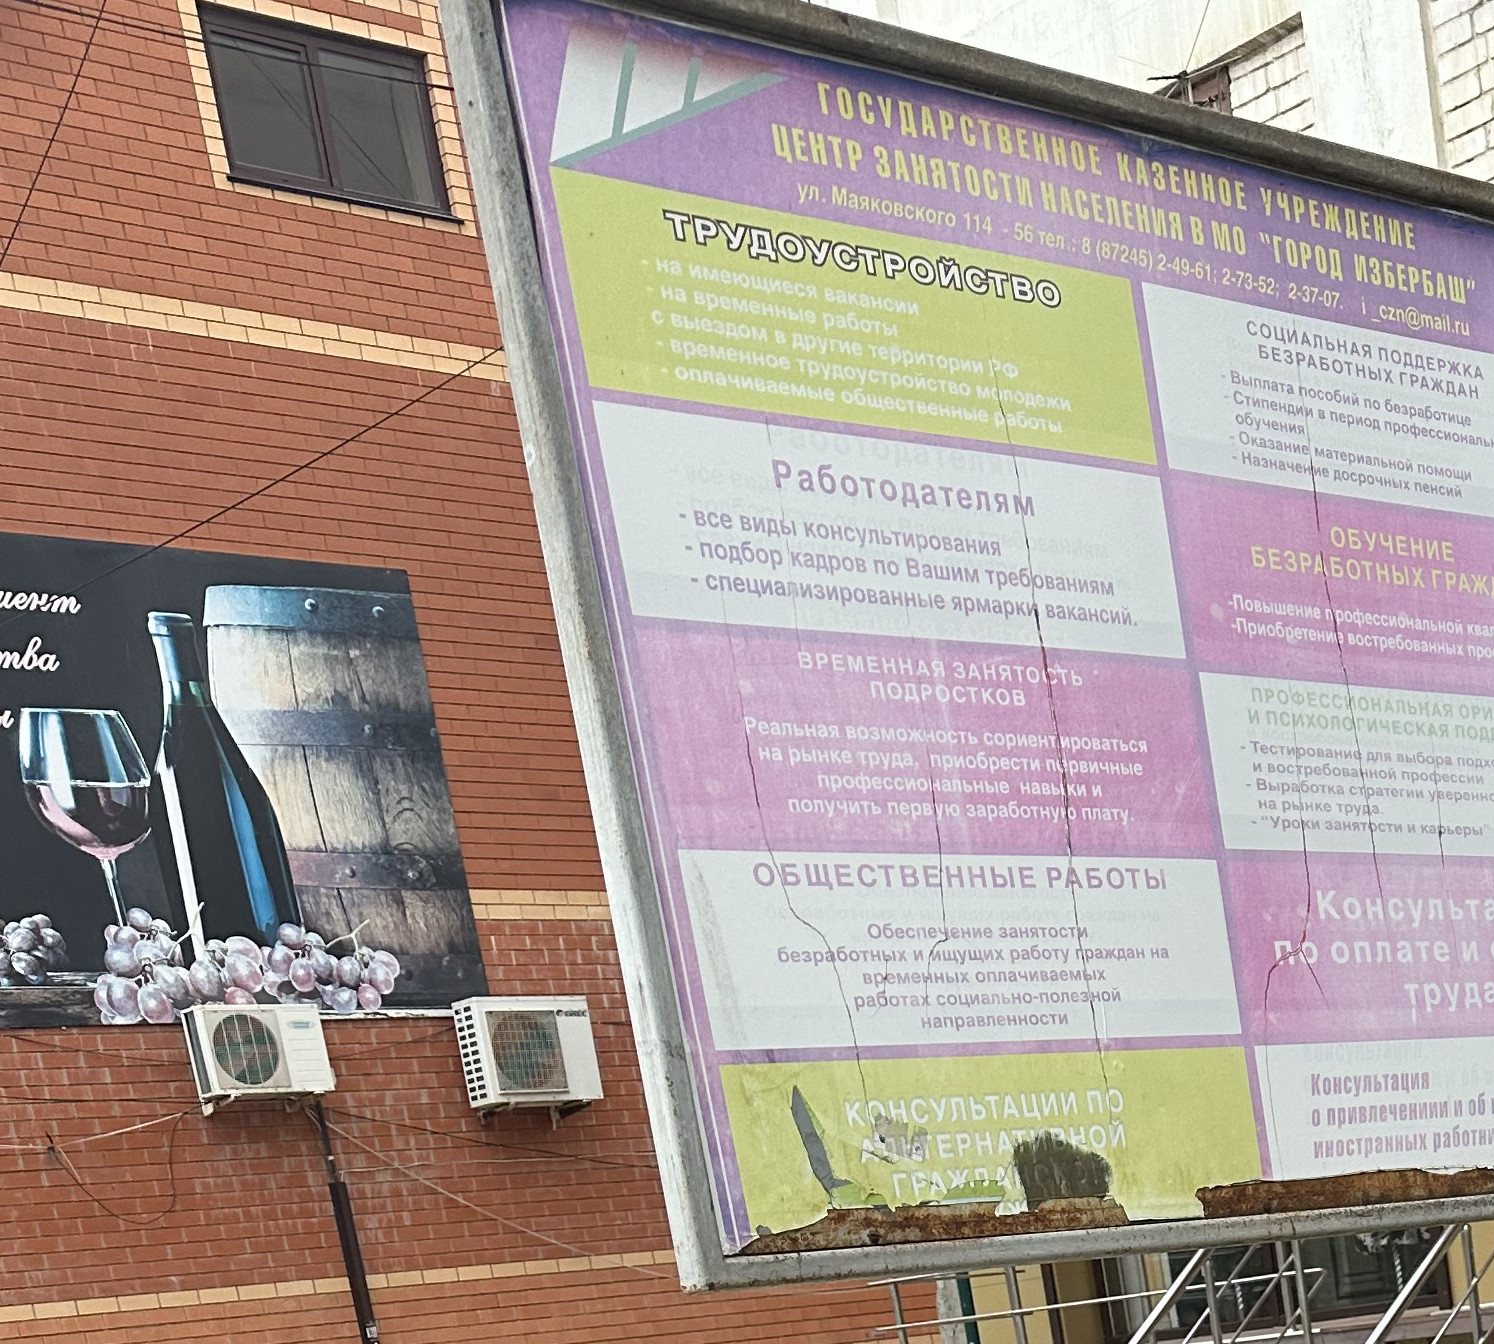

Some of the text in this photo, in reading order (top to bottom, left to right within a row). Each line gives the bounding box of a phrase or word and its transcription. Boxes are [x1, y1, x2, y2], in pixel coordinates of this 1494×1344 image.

[817, 82, 1416, 251] ГОСУДАРСТВЕННОЕ КАЗЕННОЕ УЧРЕЖДЕНИЕ
[771, 123, 862, 172] ЦЕНТР
[873, 145, 1033, 208] ЗАНЯТОСТИ
[1040, 181, 1184, 242] НАСЕЛЕНИЯ
[1189, 215, 1204, 246] В
[1210, 220, 1246, 256] МО
[661, 208, 1062, 309] ТРУДОУСТРОЙСТВО
[796, 182, 826, 204] ул.
[831, 185, 956, 228] Маяковского
[963, 212, 992, 238] 114
[1013, 222, 1034, 243] 56
[1081, 236, 1091, 255] 8
[1095, 239, 1153, 273] (87245)
[1156, 252, 1217, 286] 2-49-61;
[1221, 267, 1280, 299] 2-73-52;
[1245, 320, 1484, 381] СОЦИАЛЬНАЯ ПОДДЕРЖКА
[1257, 343, 1479, 399] БЕЗРАБОТНЫХ ГРАЖДАН
[1229, 369, 1472, 427] Выплата пособий по безработице
[1232, 390, 1314, 422] Стипендии
[1317, 408, 1326, 420] в
[1329, 410, 1381, 432] период
[771, 459, 1035, 524] Работодателям
[693, 509, 1002, 557] все виды консультирования
[1330, 525, 1454, 562] ОБУЧЕНИЕ
[699, 540, 1115, 597] подбор кадров по Вашим требованиям
[1250, 545, 1425, 588] БЕЗРАБОТНЫХ
[705, 573, 1138, 627] специализированные ярмарки вакансий.
[797, 650, 1083, 688] ВРЕМЕННАЯ ЗАНЯТОСТЬ
[870, 680, 1026, 707] ПОДРОСТКОВ
[752, 858, 1167, 895] ОБЩЕСТВЕННЫЕ РАБОТЫ
[866, 921, 1089, 945] Обеспечение занятости
[1273, 936, 1319, 973] по
[1330, 940, 1450, 964] оплате
[1460, 940, 1479, 962] и
[1310, 1071, 1430, 1098] Консультация
[840, 1089, 1123, 1131] КОНСУЛЬТАЦИИ ПО
[1311, 1108, 1321, 1127] о
[1453, 1099, 1463, 1117] и
[1467, 1091, 1486, 1117] об
[1313, 1132, 1427, 1159] иностранных
